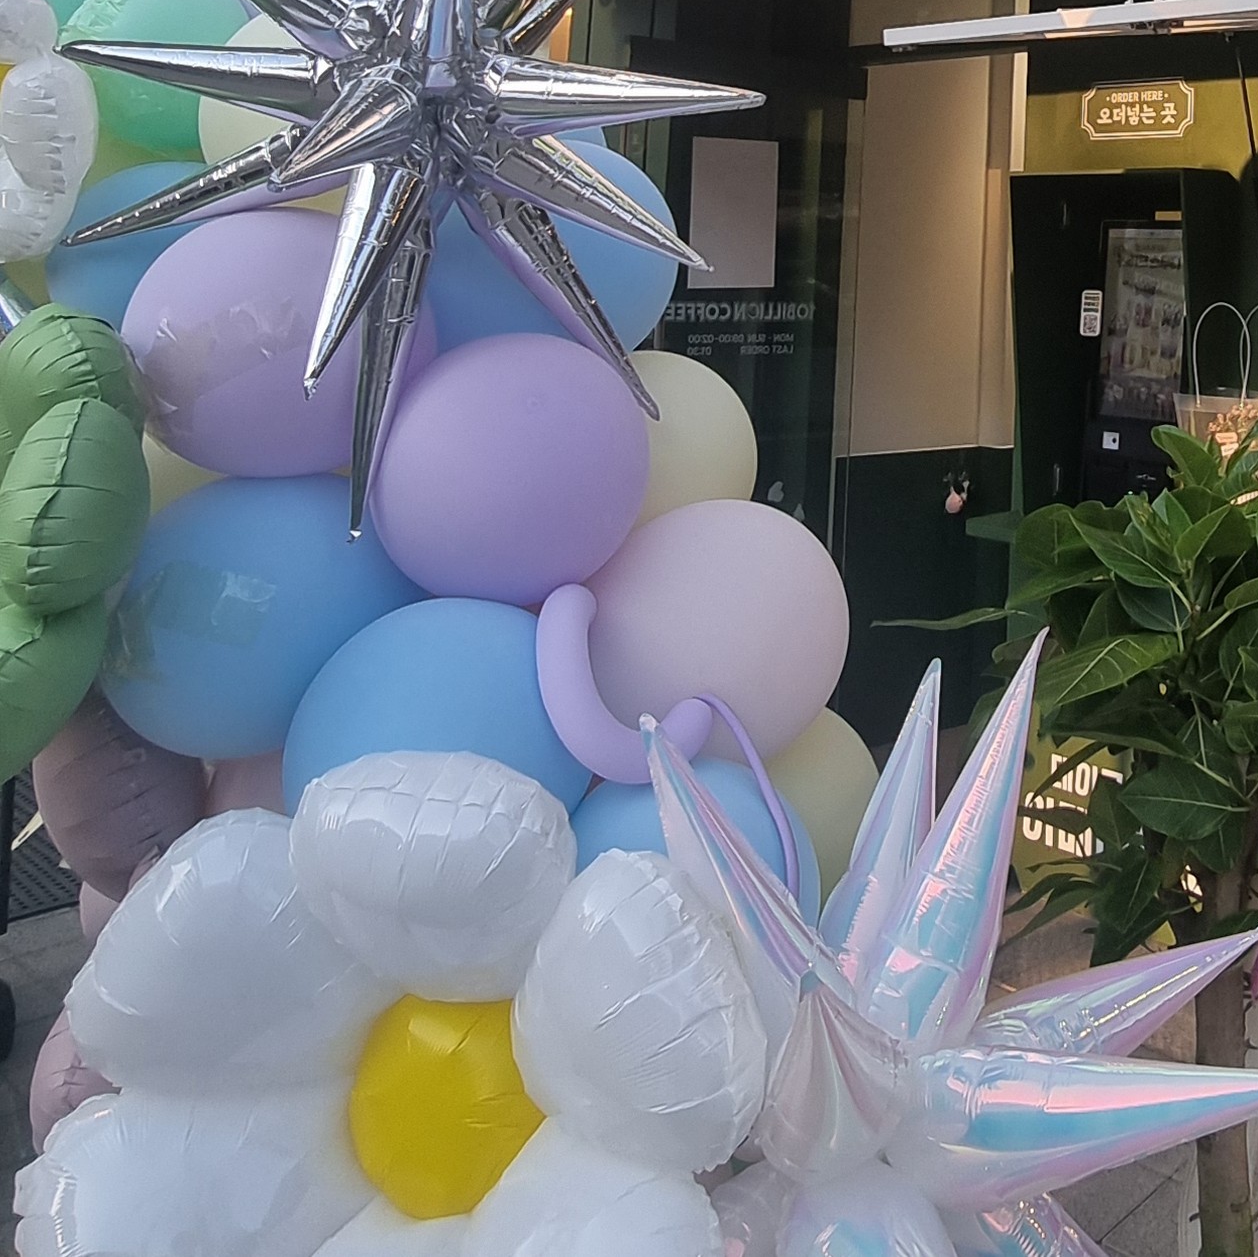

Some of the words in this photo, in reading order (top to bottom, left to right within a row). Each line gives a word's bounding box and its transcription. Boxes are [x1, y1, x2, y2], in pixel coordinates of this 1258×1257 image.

[1111, 91, 1139, 103] ORDER
[1141, 90, 1164, 101] HERE
[1160, 102, 1178, 124] 곳
